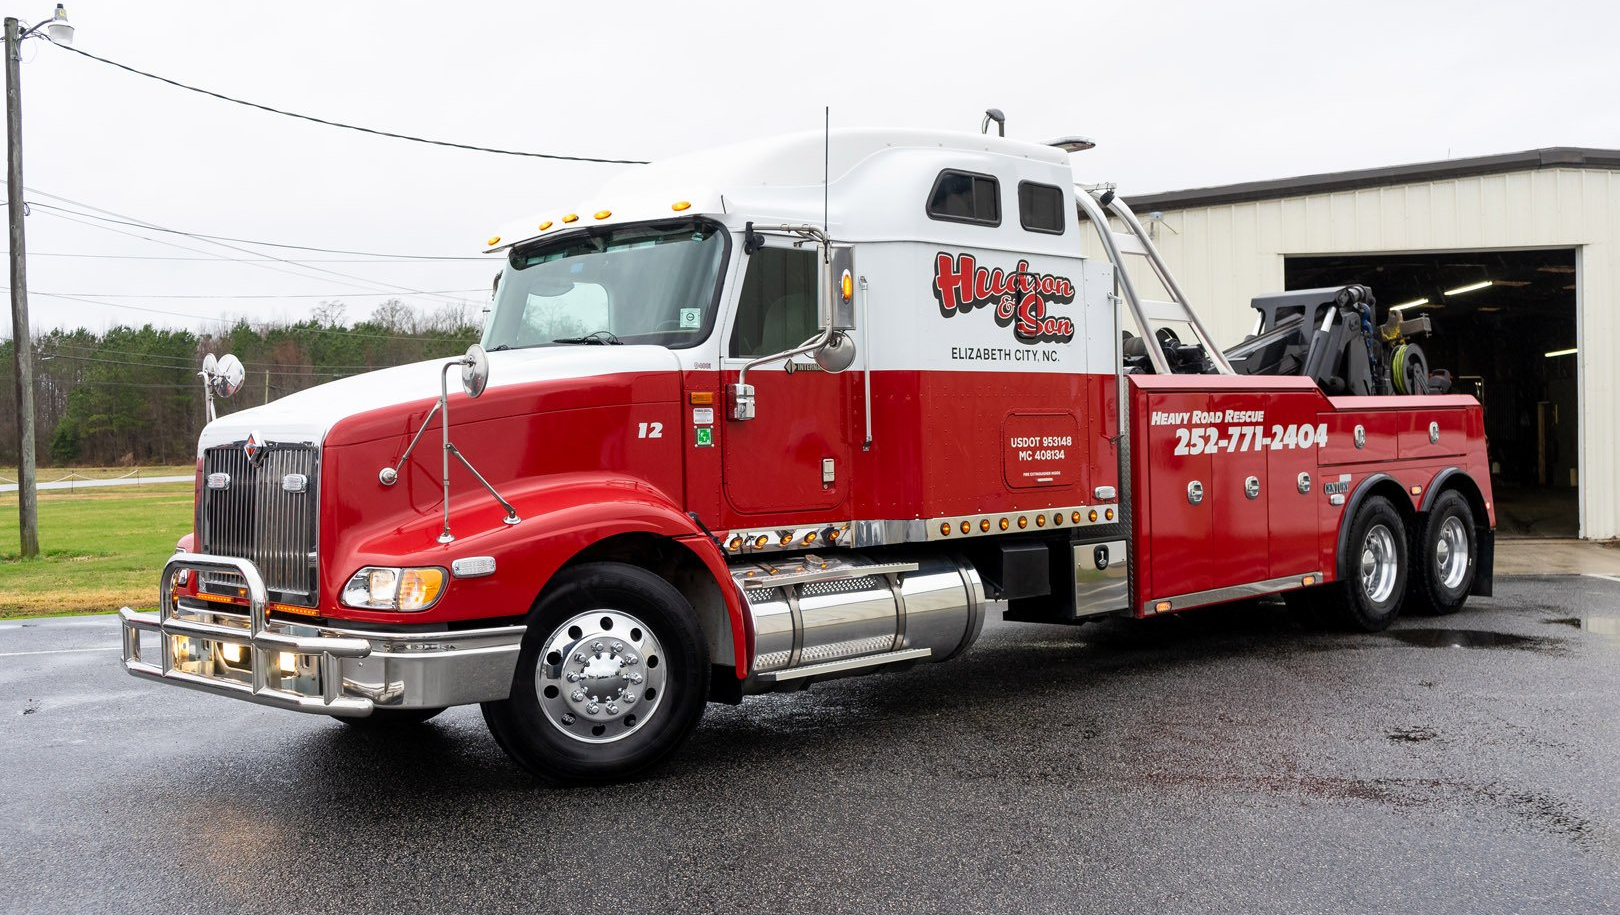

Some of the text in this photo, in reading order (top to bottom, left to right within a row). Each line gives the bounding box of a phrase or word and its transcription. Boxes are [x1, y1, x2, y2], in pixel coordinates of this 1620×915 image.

[934, 252, 1075, 314] Hudson
[996, 292, 1074, 340] & Son
[951, 347, 1060, 362] ELIZABETH CITY, NC.
[797, 362, 822, 371] INTERNA
[1151, 410, 1264, 425] HEAVY ROAD RESCUE
[638, 422, 663, 438] 12
[1011, 436, 1072, 447] USDOT 953148
[1174, 423, 1328, 456] 252-771-2404
[1019, 450, 1065, 461] MC 408134
